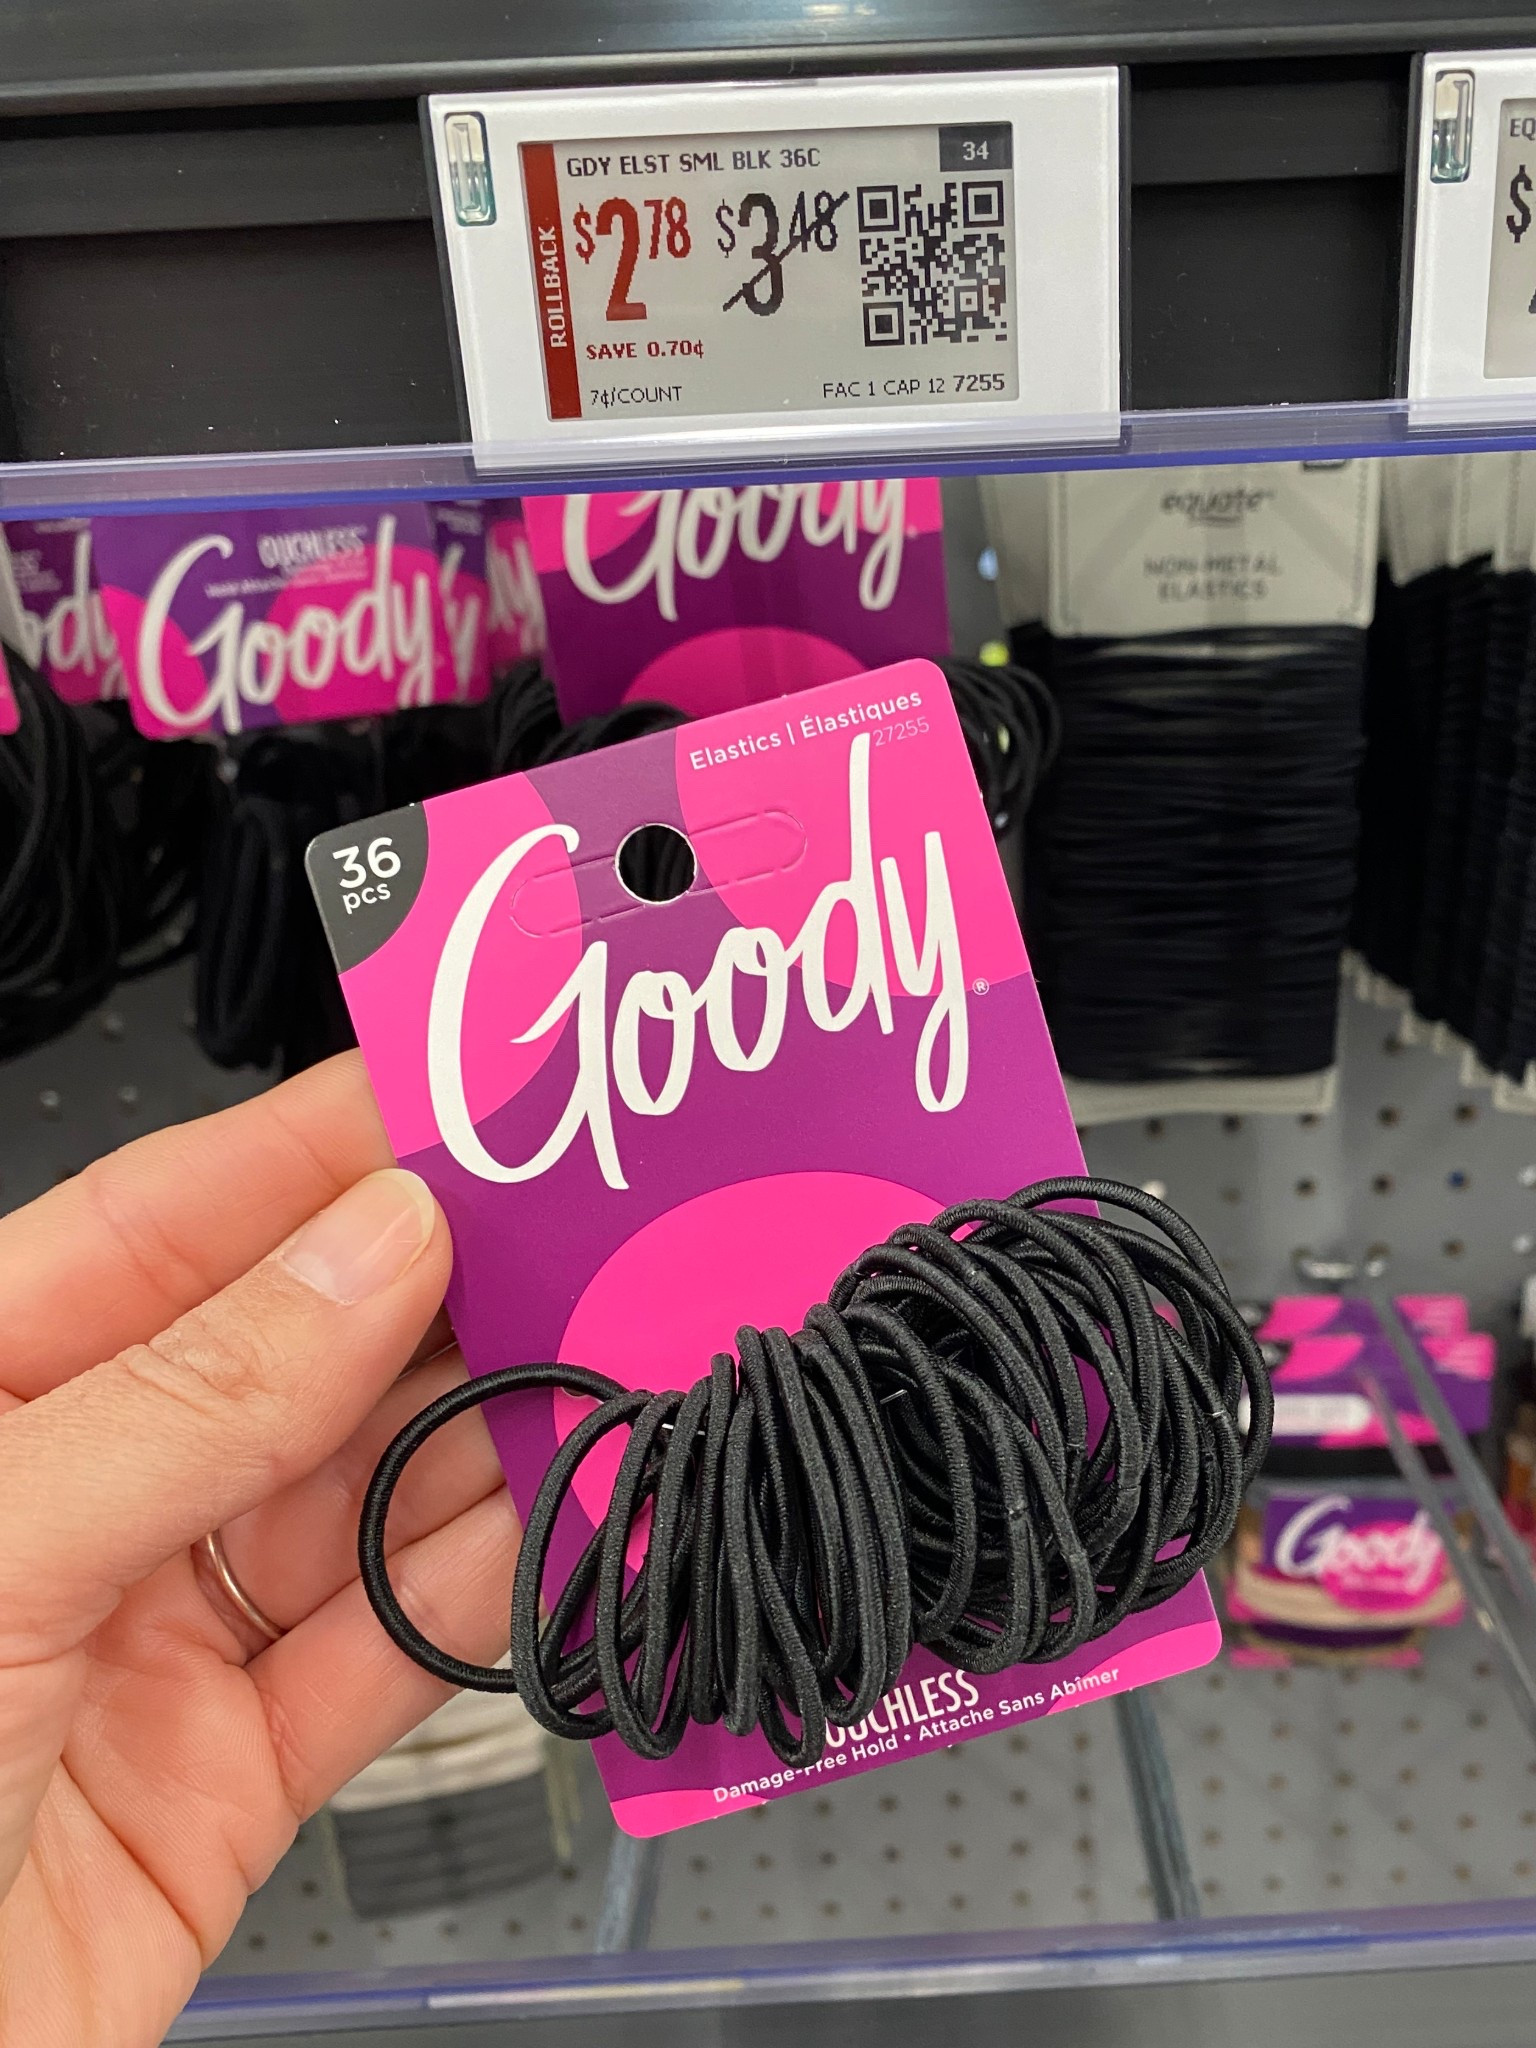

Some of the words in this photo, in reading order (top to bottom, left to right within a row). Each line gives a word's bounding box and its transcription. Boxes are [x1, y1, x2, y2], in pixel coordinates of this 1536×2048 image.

[566, 156, 612, 177] GDY
[620, 154, 670, 175] ELST
[679, 151, 725, 172] SML
[732, 149, 772, 171] BLK
[780, 147, 822, 168] 36C
[961, 141, 990, 162] 34
[538, 226, 567, 348] ROLLBACK
[586, 342, 637, 360] SAVE
[647, 340, 704, 359] 0.70¢
[589, 385, 683, 407] 7¢/COUNT
[823, 382, 861, 399] FAC
[868, 381, 875, 397] 1
[883, 378, 921, 396] CAP
[929, 377, 946, 393] 12
[953, 373, 1006, 393] 7255
[136, 513, 437, 734] Goody
[689, 731, 782, 770] Elastics
[799, 692, 923, 739] Élastiques
[872, 716, 930, 748] 27255
[332, 837, 401, 889] 36
[342, 883, 391, 915] pcs
[427, 732, 970, 1191] Goody
[713, 1753, 847, 1803] Damage-Free
[851, 1734, 898, 1761] Hold
[918, 1707, 995, 1741] Attache
[999, 1691, 1045, 1715] Sans
[1050, 1668, 1120, 1700] Abîmer
